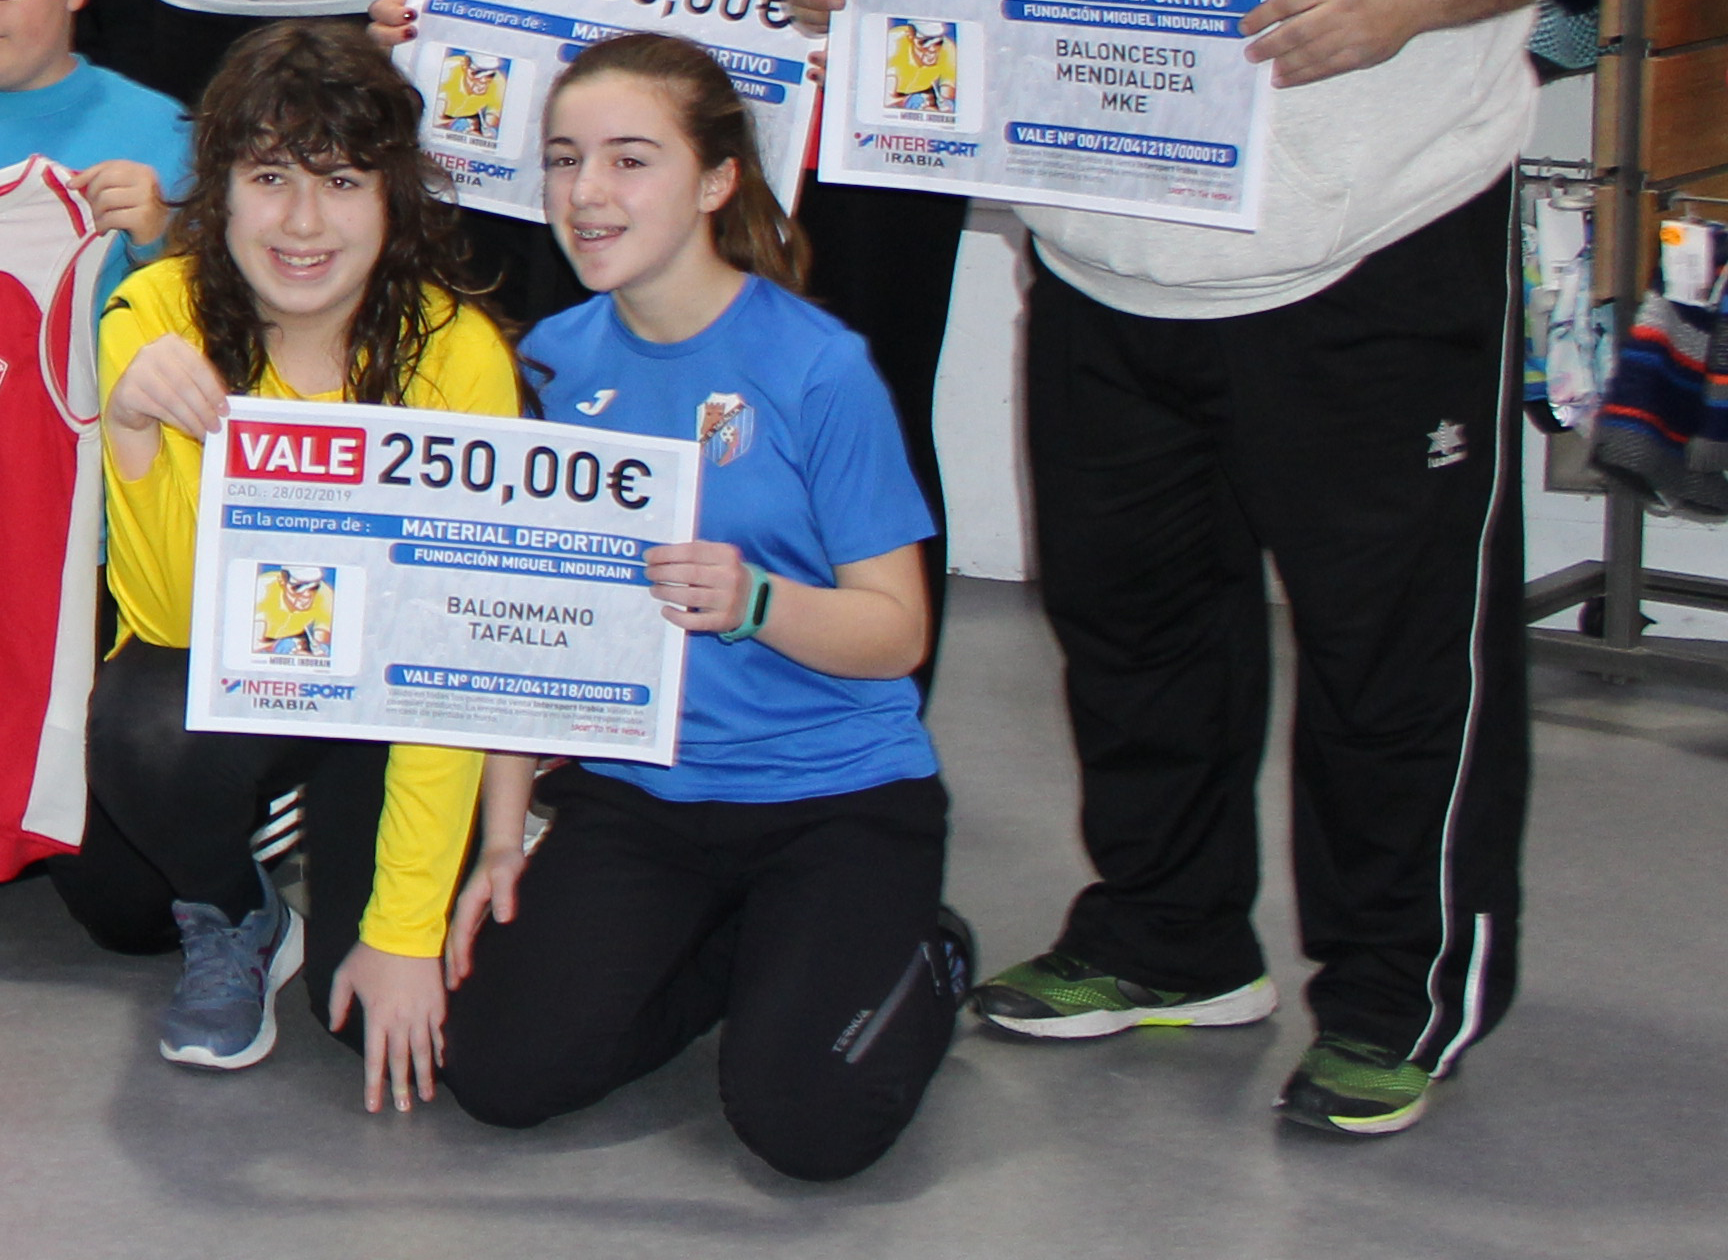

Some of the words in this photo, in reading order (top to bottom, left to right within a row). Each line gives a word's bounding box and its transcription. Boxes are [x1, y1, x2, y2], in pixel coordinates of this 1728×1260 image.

[1023, 2, 1099, 23] FUNDACIÓN
[1102, 8, 1154, 27] MIGUEL
[1157, 13, 1225, 33] INDURAIN
[1056, 39, 1196, 68] BALONCESTO
[1056, 63, 1195, 94] MENDIALDEA
[1101, 92, 1148, 114] MKE
[875, 135, 981, 158] INTERSPORT
[1017, 126, 1055, 144] VALE
[885, 152, 944, 168] IRABIA
[240, 432, 358, 477] VALE
[378, 432, 653, 510] 250,00€
[271, 485, 352, 503] 28/02/2019
[232, 510, 252, 525] En
[256, 511, 273, 526] la
[277, 515, 337, 533] compra
[340, 516, 361, 532] de
[402, 518, 512, 544] MATERIAL
[515, 528, 636, 557] DEPORTIVO
[413, 547, 498, 567] FUNDACIÓN
[502, 555, 557, 573] MIGUEL
[560, 559, 632, 580] INDURAIN
[446, 596, 595, 627] BALONMANO
[468, 622, 570, 649] TAFALLA
[242, 679, 356, 701] INTERSPORT
[403, 668, 445, 685] VALE
[471, 675, 632, 702] 00/12/041218/00015
[252, 698, 319, 713] IRABIA
